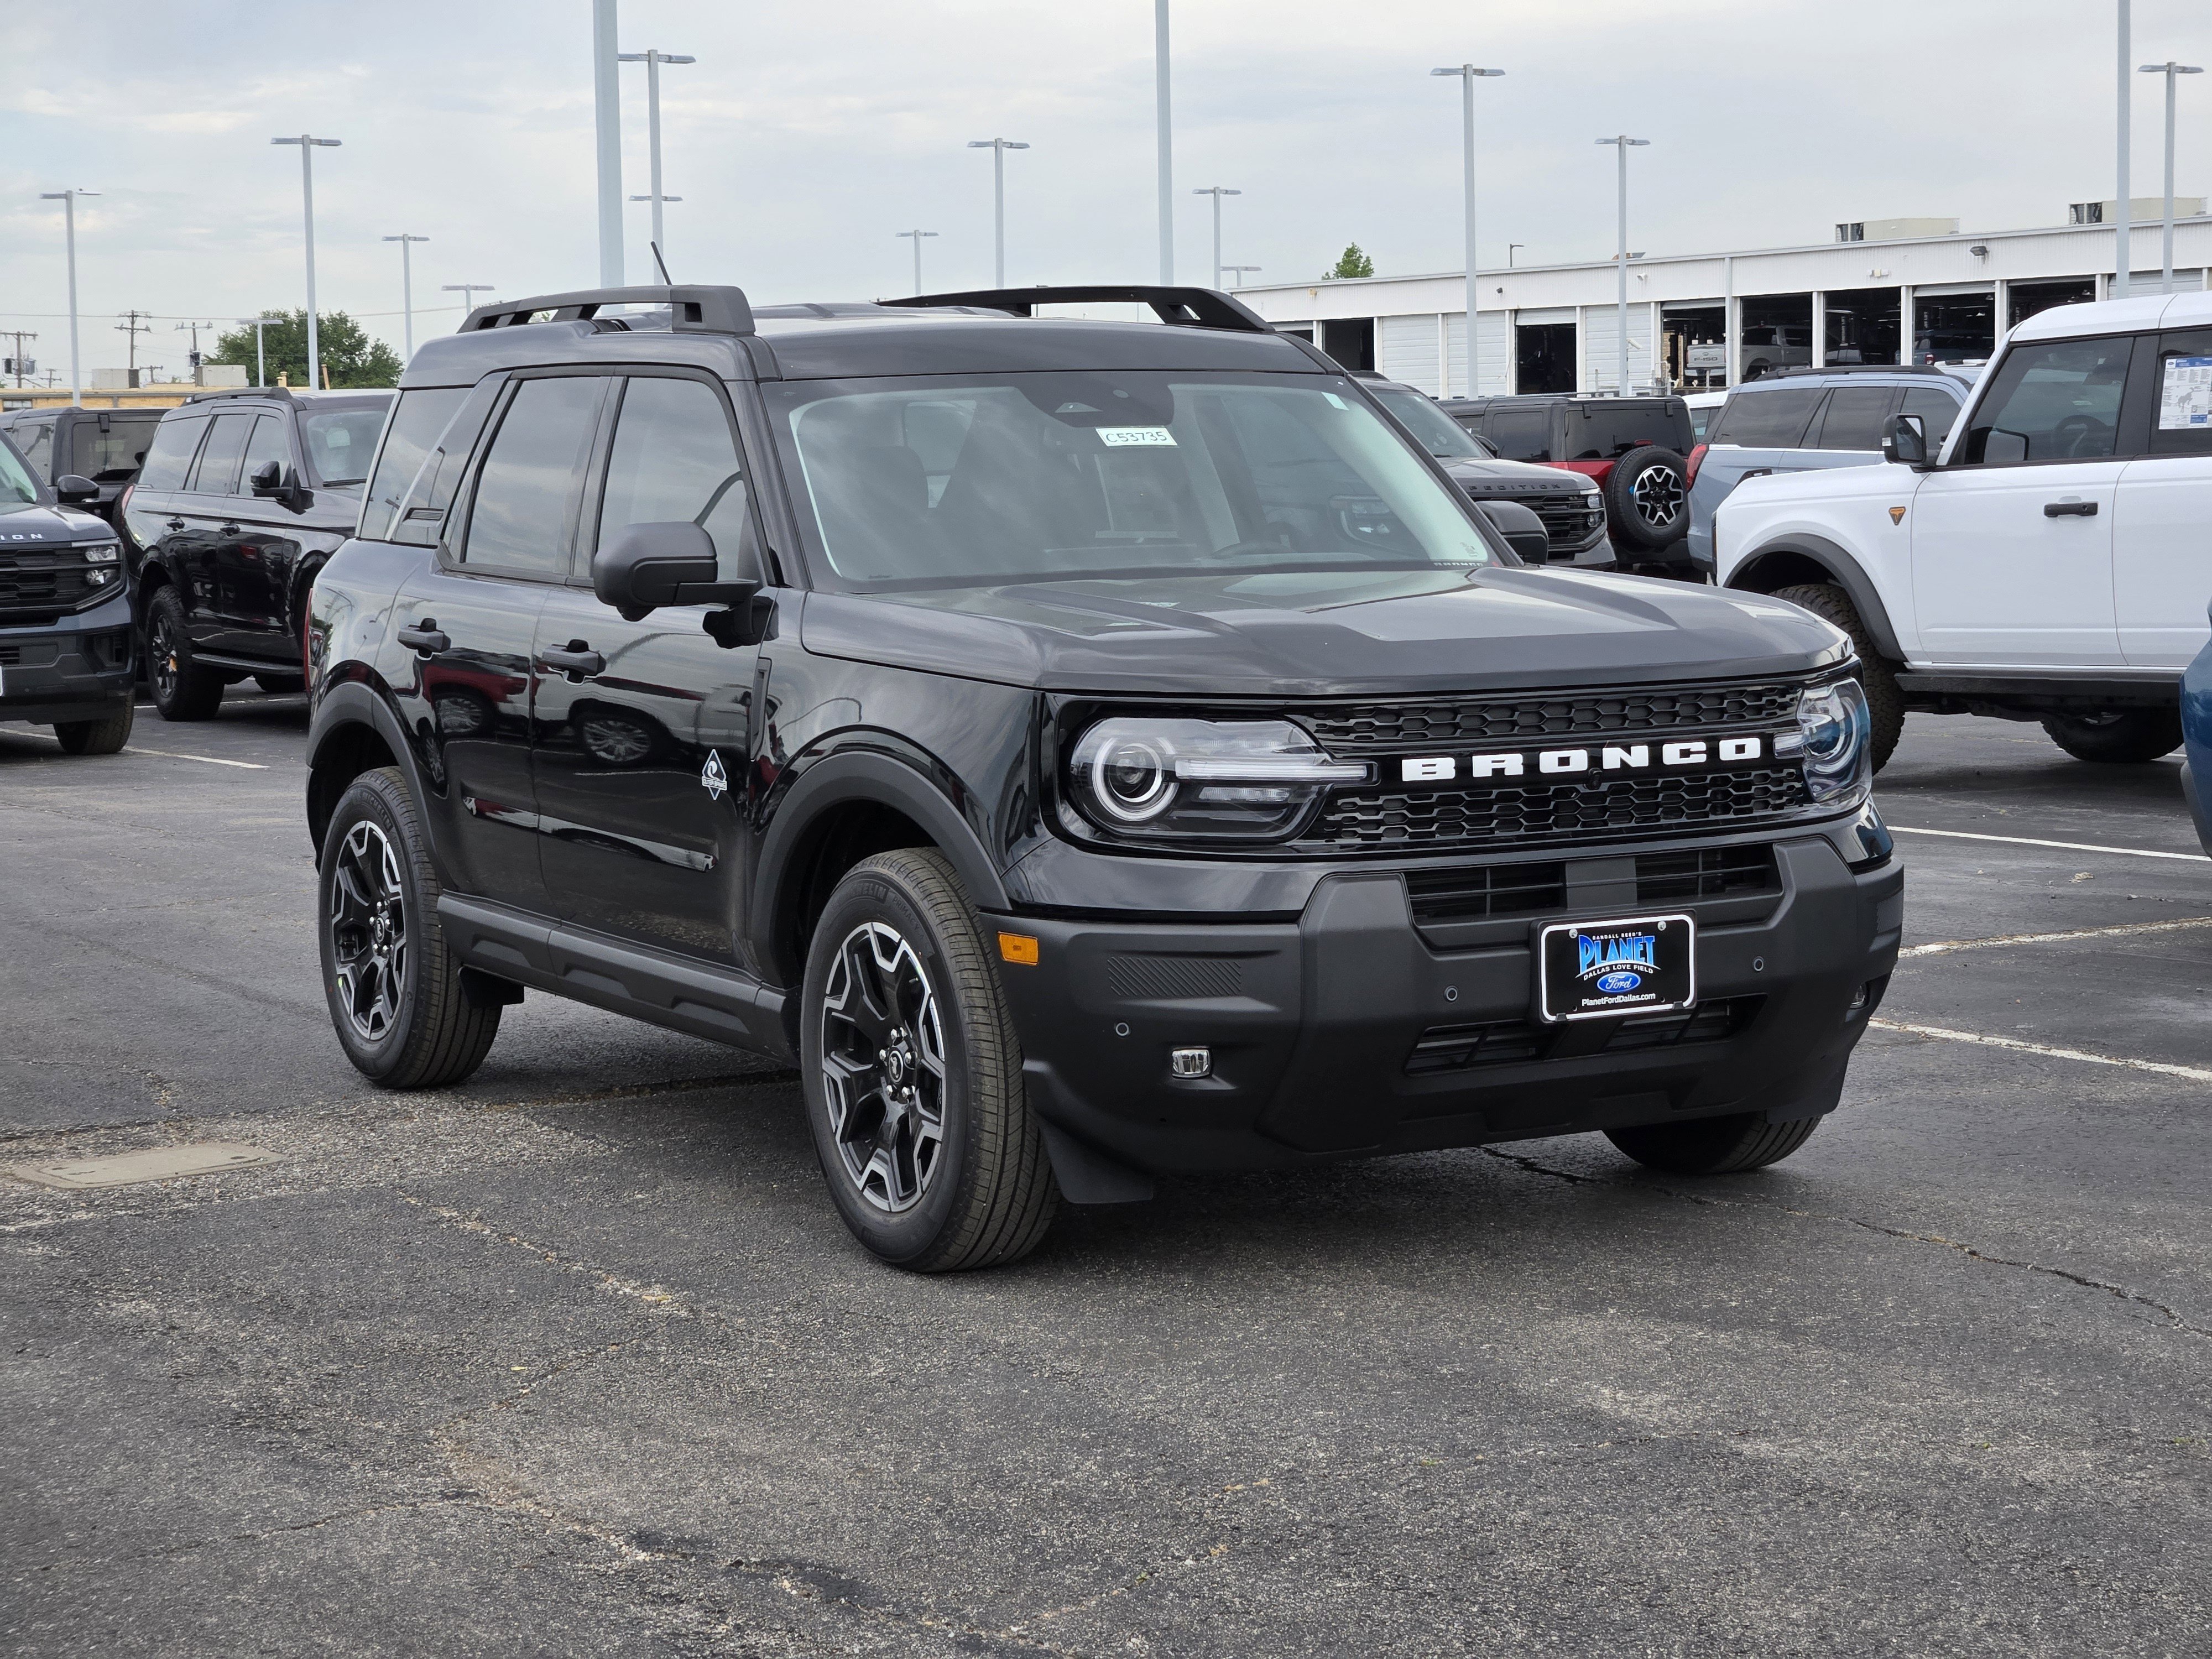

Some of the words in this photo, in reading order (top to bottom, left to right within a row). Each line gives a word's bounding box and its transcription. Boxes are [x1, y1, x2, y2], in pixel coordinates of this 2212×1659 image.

[1105, 431, 1167, 442] C53735
[1401, 737, 1761, 782] BRONCO
[1578, 934, 1656, 974] PLANET
[1583, 966, 1610, 981] DALLAS
[1634, 964, 1653, 974] FIELD
[1605, 975, 1632, 990] Ford
[1582, 993, 1656, 1006] PlanetFordDallas.com
